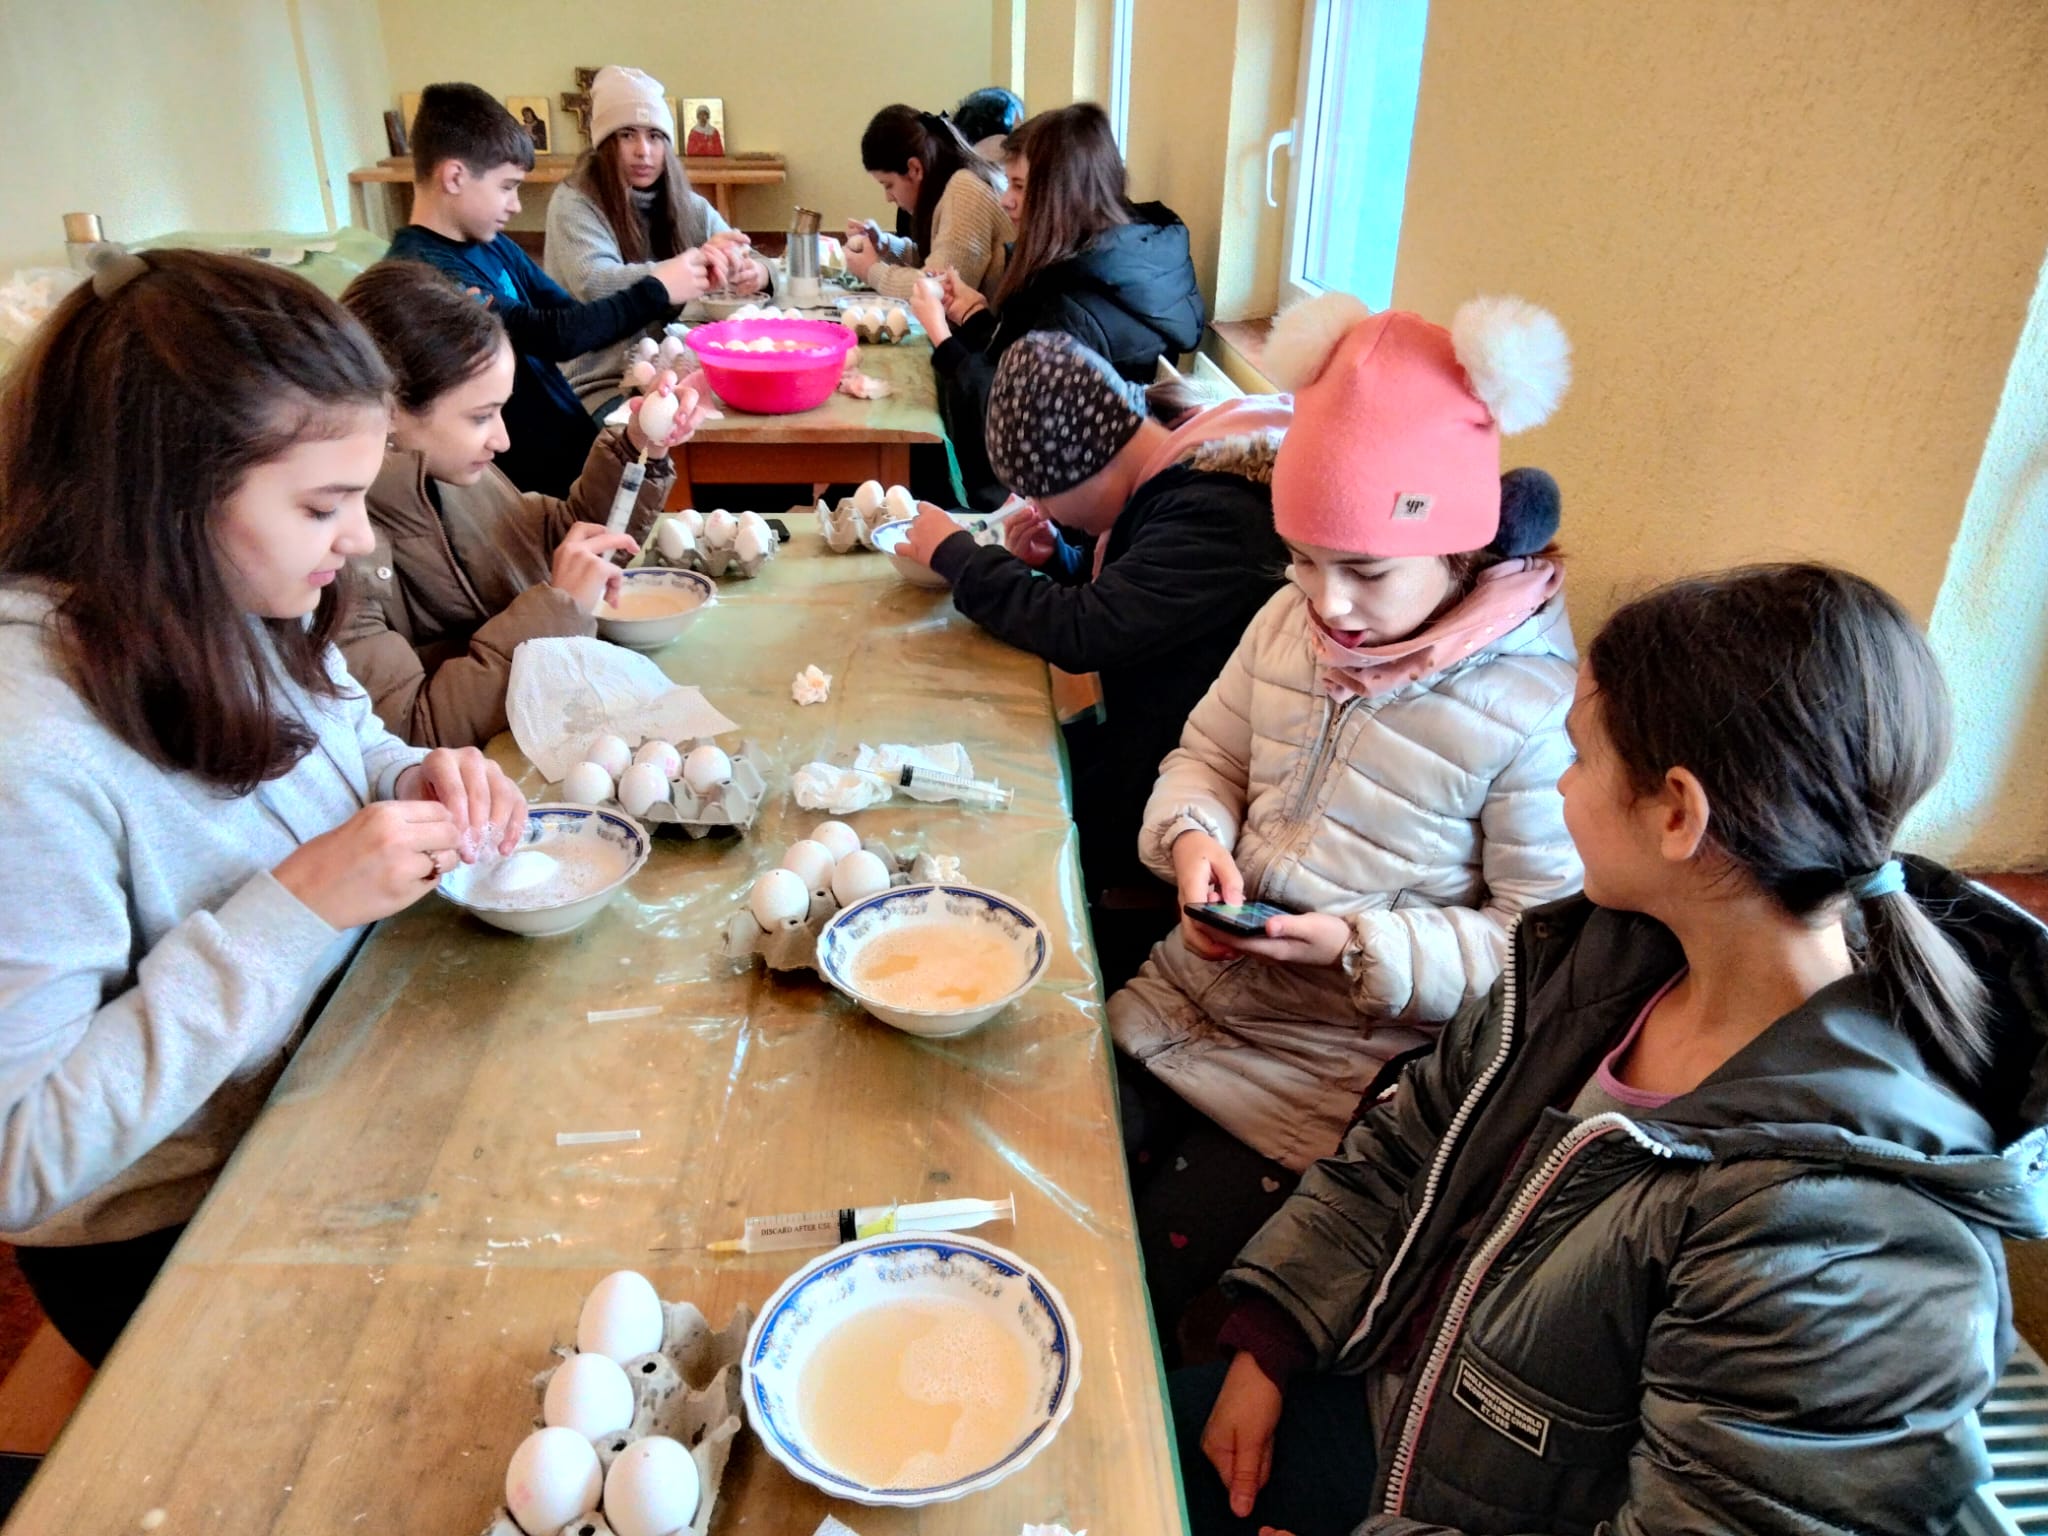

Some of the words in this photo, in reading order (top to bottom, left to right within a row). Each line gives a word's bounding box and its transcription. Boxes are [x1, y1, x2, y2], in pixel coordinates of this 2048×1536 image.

[760, 1226, 792, 1236] DISCARD
[794, 1223, 817, 1233] AFTER
[1482, 1385, 1515, 1414] ANOTHER
[1514, 1407, 1543, 1430] WORLD
[1511, 1415, 1540, 1438] CHARM
